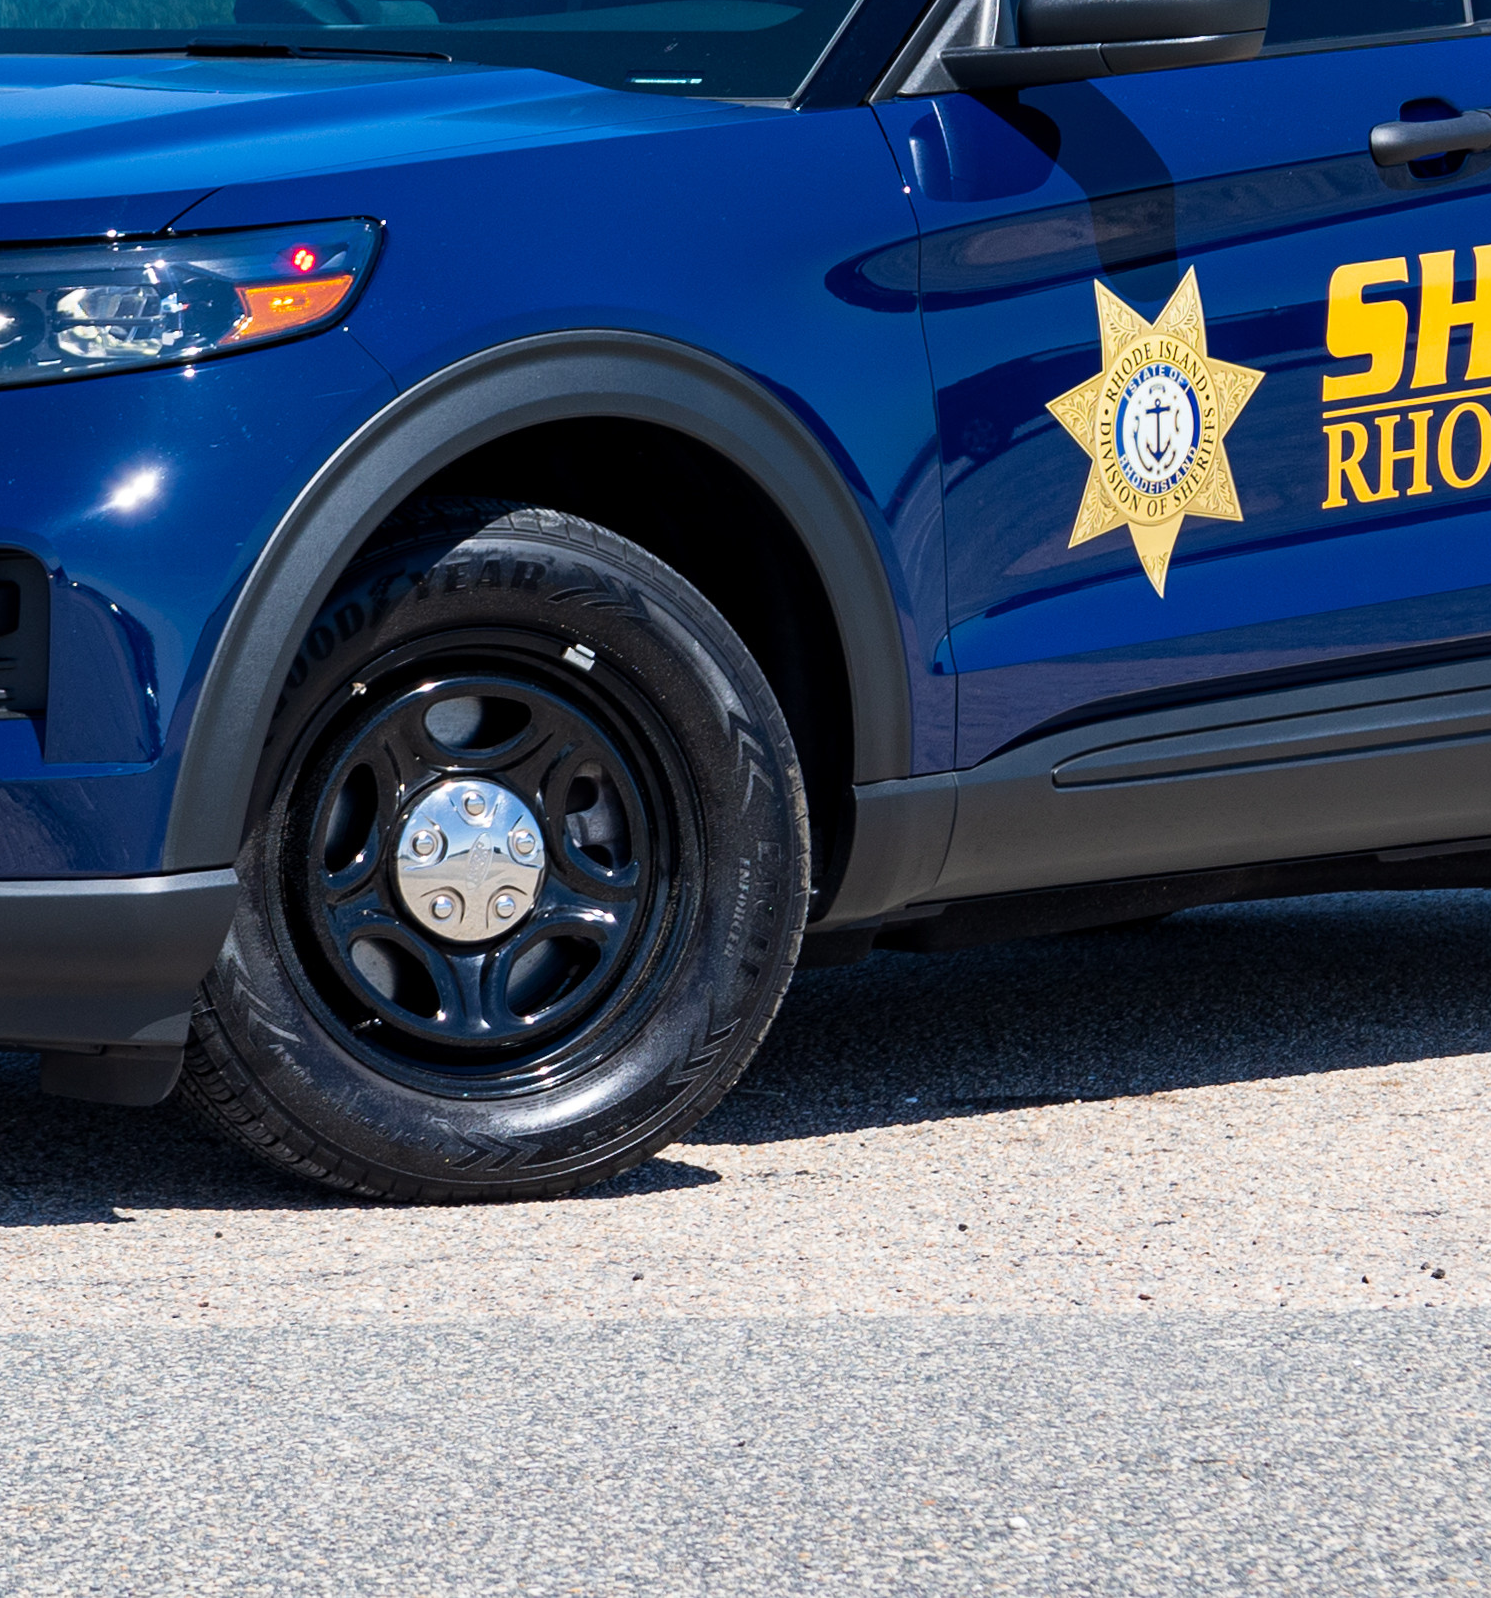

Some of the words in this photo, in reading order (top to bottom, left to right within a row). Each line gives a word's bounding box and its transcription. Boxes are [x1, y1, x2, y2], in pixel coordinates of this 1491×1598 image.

[1106, 342, 1154, 403] RHODE
[1158, 340, 1208, 393] ISLAND
[1128, 363, 1166, 394] STATE
[1168, 367, 1187, 386] OF
[1100, 421, 1142, 512] DIVISION
[1147, 497, 1168, 518] OF
[1174, 406, 1215, 508] SHERIFFS
